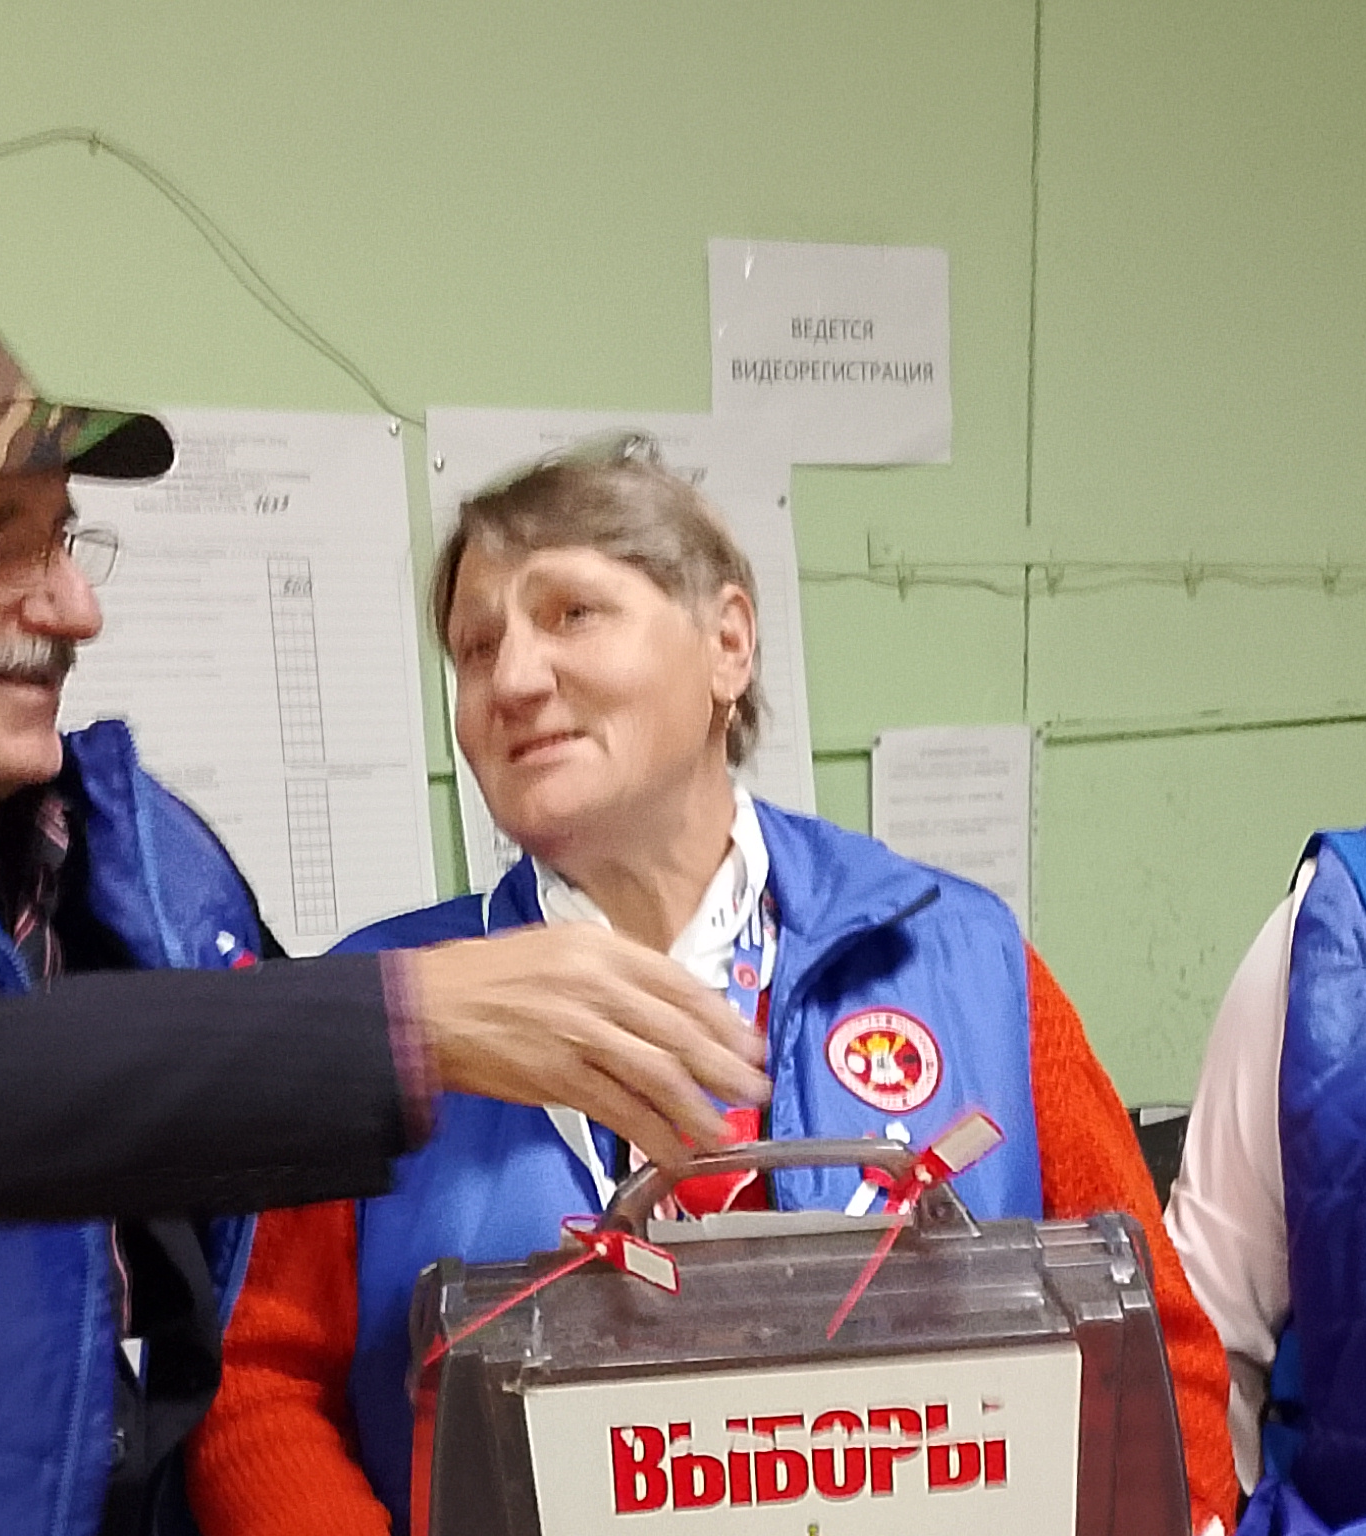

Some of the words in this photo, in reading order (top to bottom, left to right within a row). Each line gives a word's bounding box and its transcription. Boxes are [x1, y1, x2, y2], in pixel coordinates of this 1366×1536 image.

[790, 316, 874, 346] ВЕДЕТСЯ
[731, 359, 934, 387] ВИДЕОРЕГИСТРАЦИЯ
[609, 1399, 1008, 1515] ВЫБОРЫ
